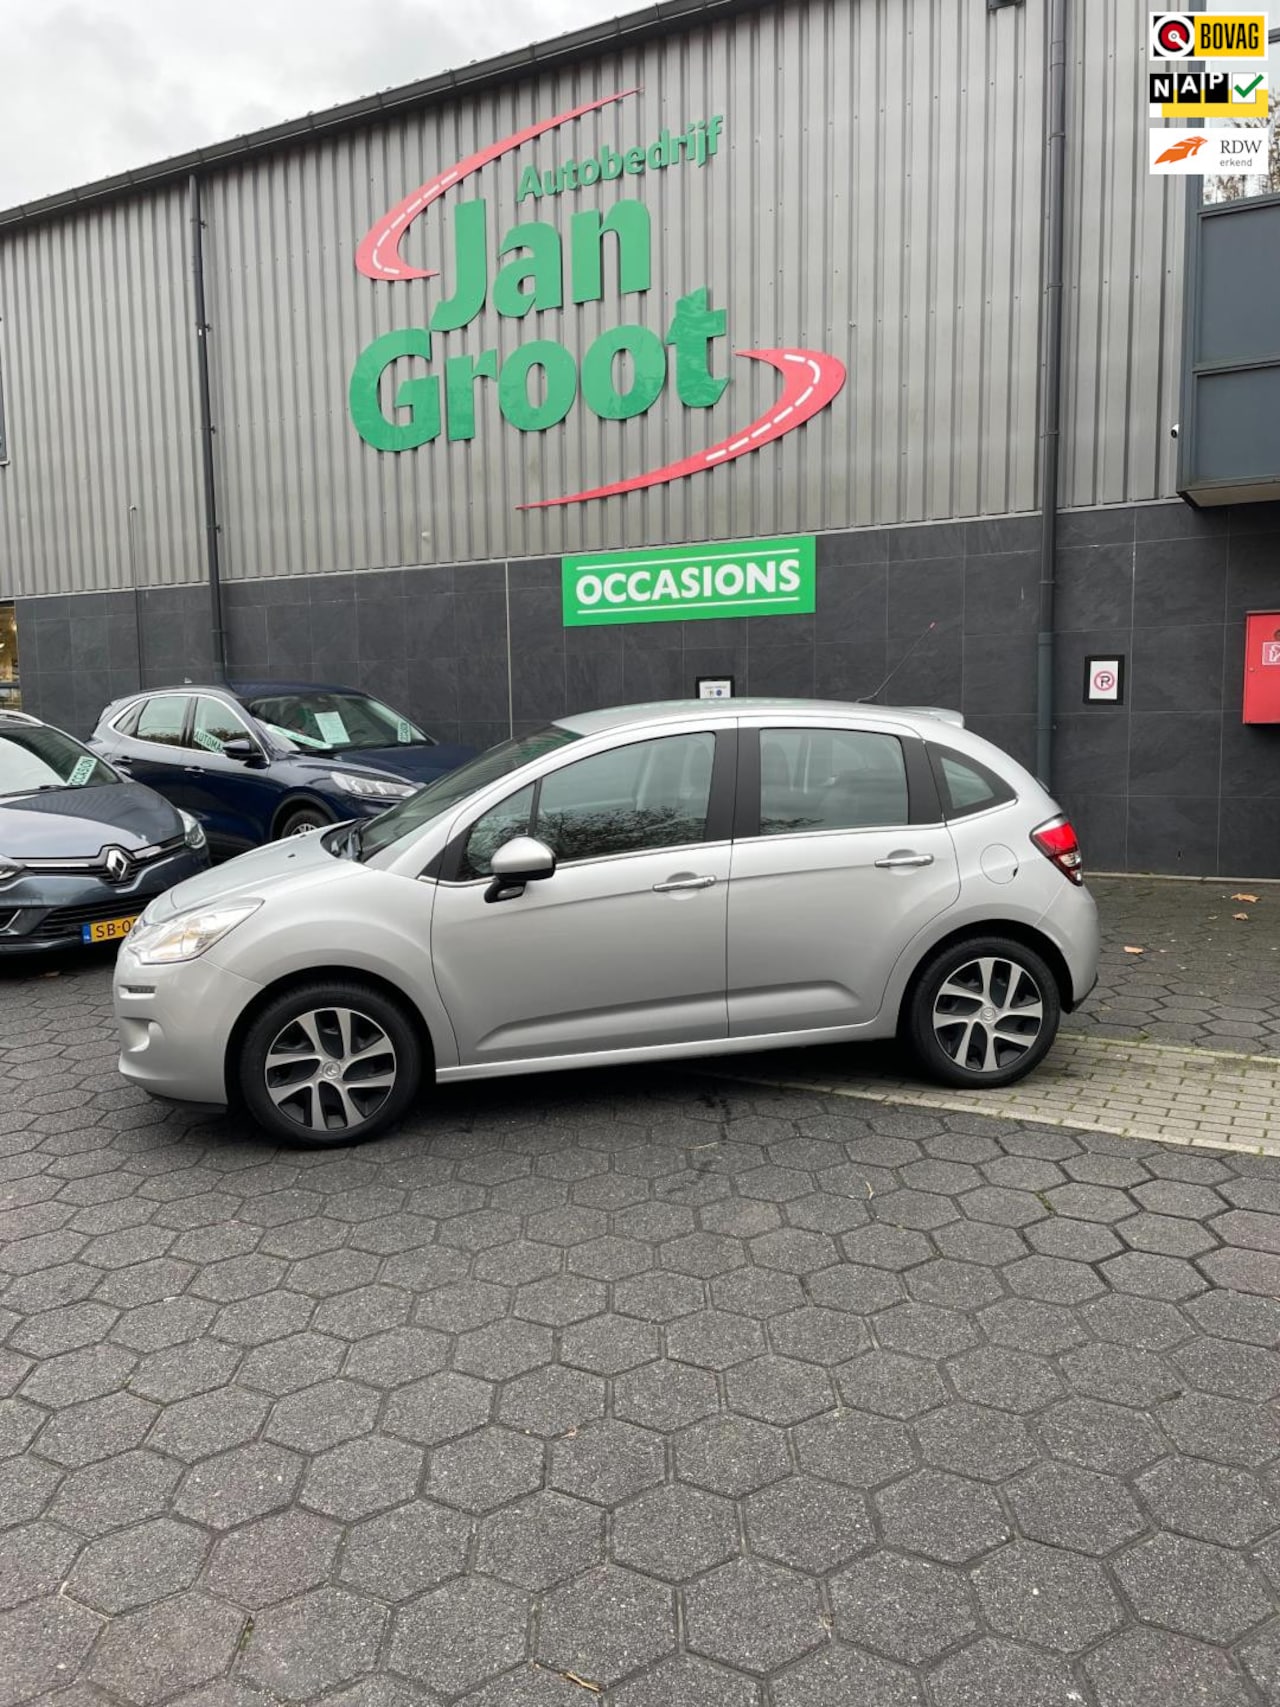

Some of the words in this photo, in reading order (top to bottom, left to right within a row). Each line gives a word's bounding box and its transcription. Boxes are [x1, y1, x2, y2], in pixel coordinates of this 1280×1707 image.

[516, 115, 723, 202] Autobedrijf
[430, 198, 651, 332] Jan
[349, 285, 730, 452] Groot
[576, 559, 800, 605] OCCASIONS
[194, 730, 225, 753] AUTOMA
[96, 919, 137, 938] SB-0
